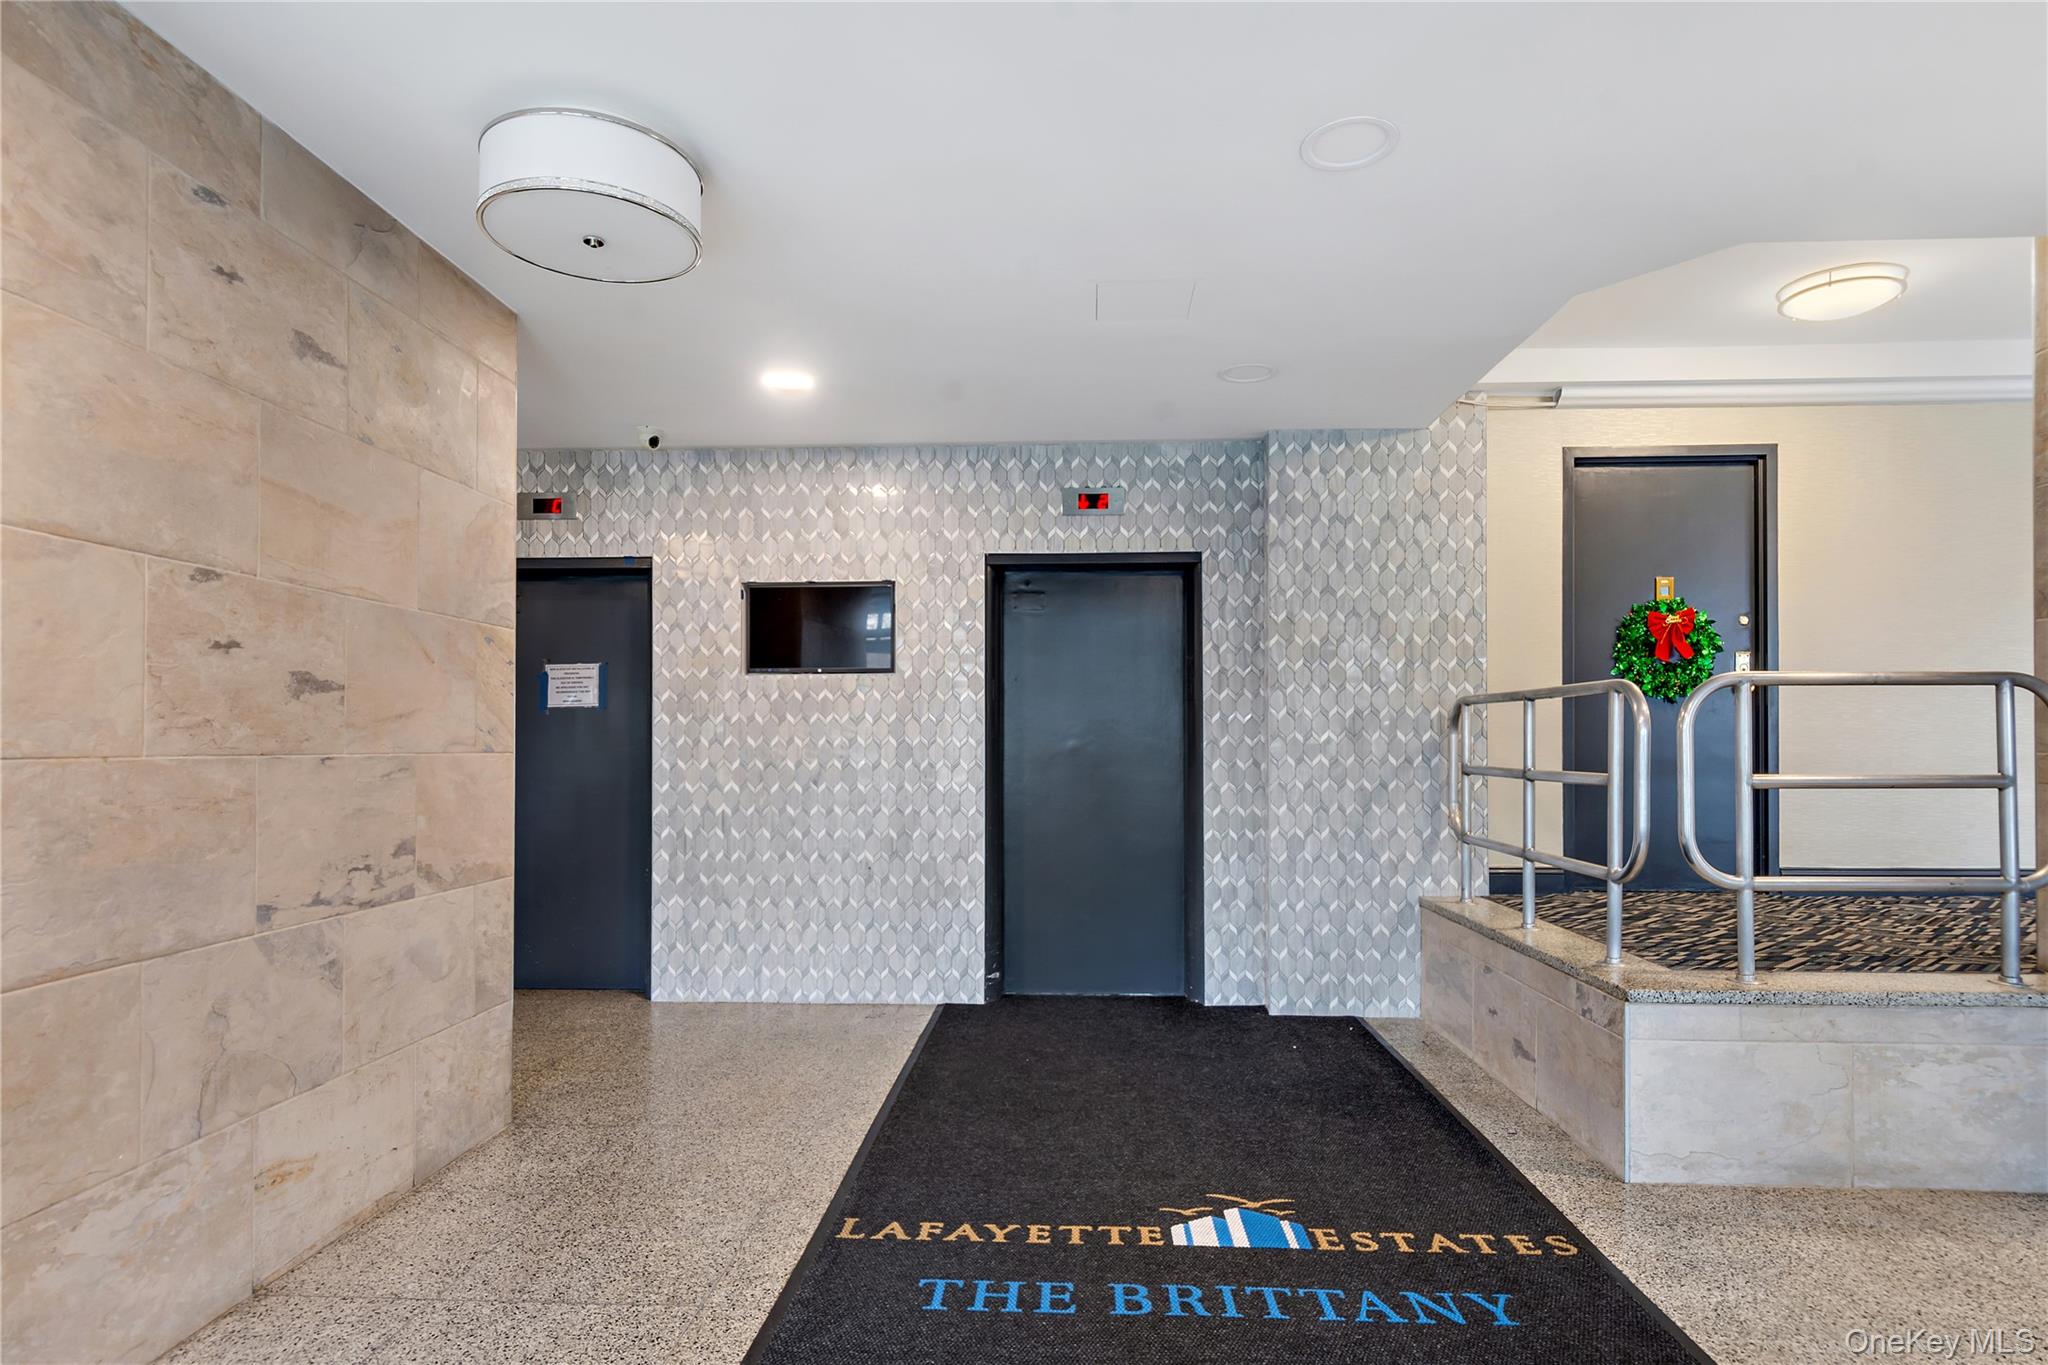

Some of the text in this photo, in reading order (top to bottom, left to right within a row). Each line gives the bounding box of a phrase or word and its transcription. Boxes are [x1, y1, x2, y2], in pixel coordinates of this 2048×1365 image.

[836, 1216, 1580, 1257] LAFAYETTE ESTATES
[918, 1277, 1523, 1327] THE BRITTANY
